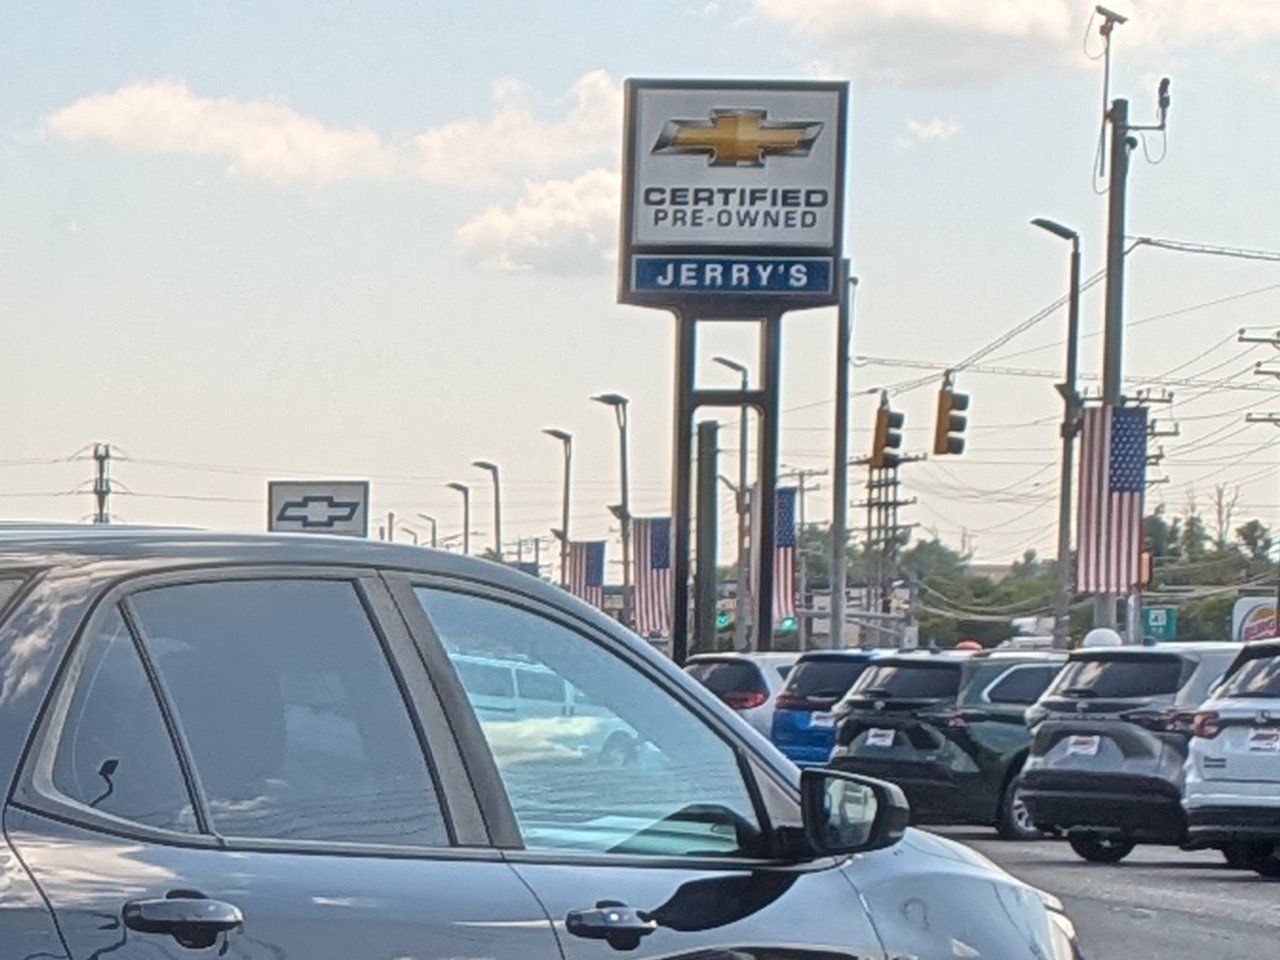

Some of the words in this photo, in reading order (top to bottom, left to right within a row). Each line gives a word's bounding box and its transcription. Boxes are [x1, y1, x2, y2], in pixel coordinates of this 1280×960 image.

[643, 187, 829, 208] CERTIFIED
[653, 208, 818, 229] PRE-OWNED
[656, 263, 809, 287] JERRY'S
